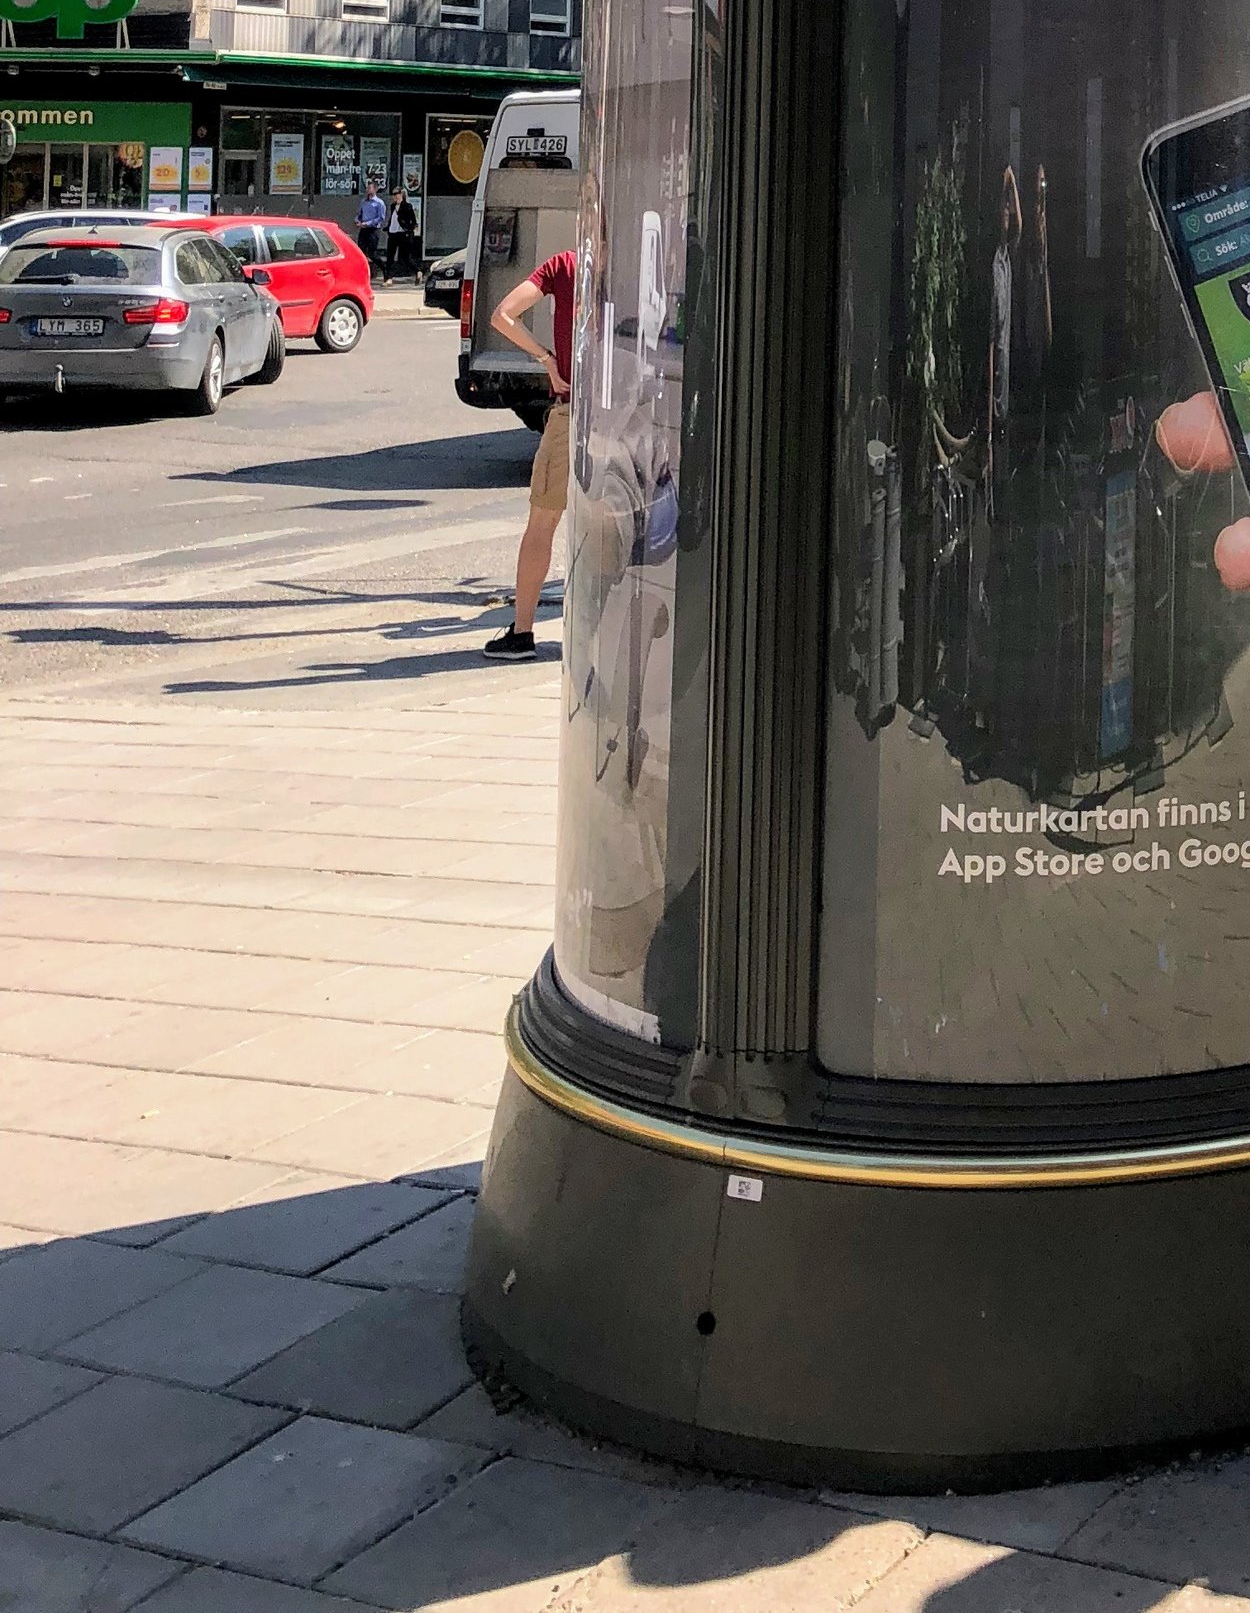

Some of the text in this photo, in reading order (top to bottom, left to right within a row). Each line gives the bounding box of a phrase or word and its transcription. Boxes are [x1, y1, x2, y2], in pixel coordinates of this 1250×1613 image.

[509, 138, 563, 151] SYL 426
[1195, 189, 1217, 203] TELIA
[1204, 199, 1249, 224] Område:
[1215, 238, 1238, 257] Sök:
[38, 317, 101, 331] LYM 365
[940, 791, 1246, 834] Naturkartan finns i
[938, 849, 1007, 884] App
[1013, 845, 1105, 877] Store
[1112, 843, 1171, 874] och
